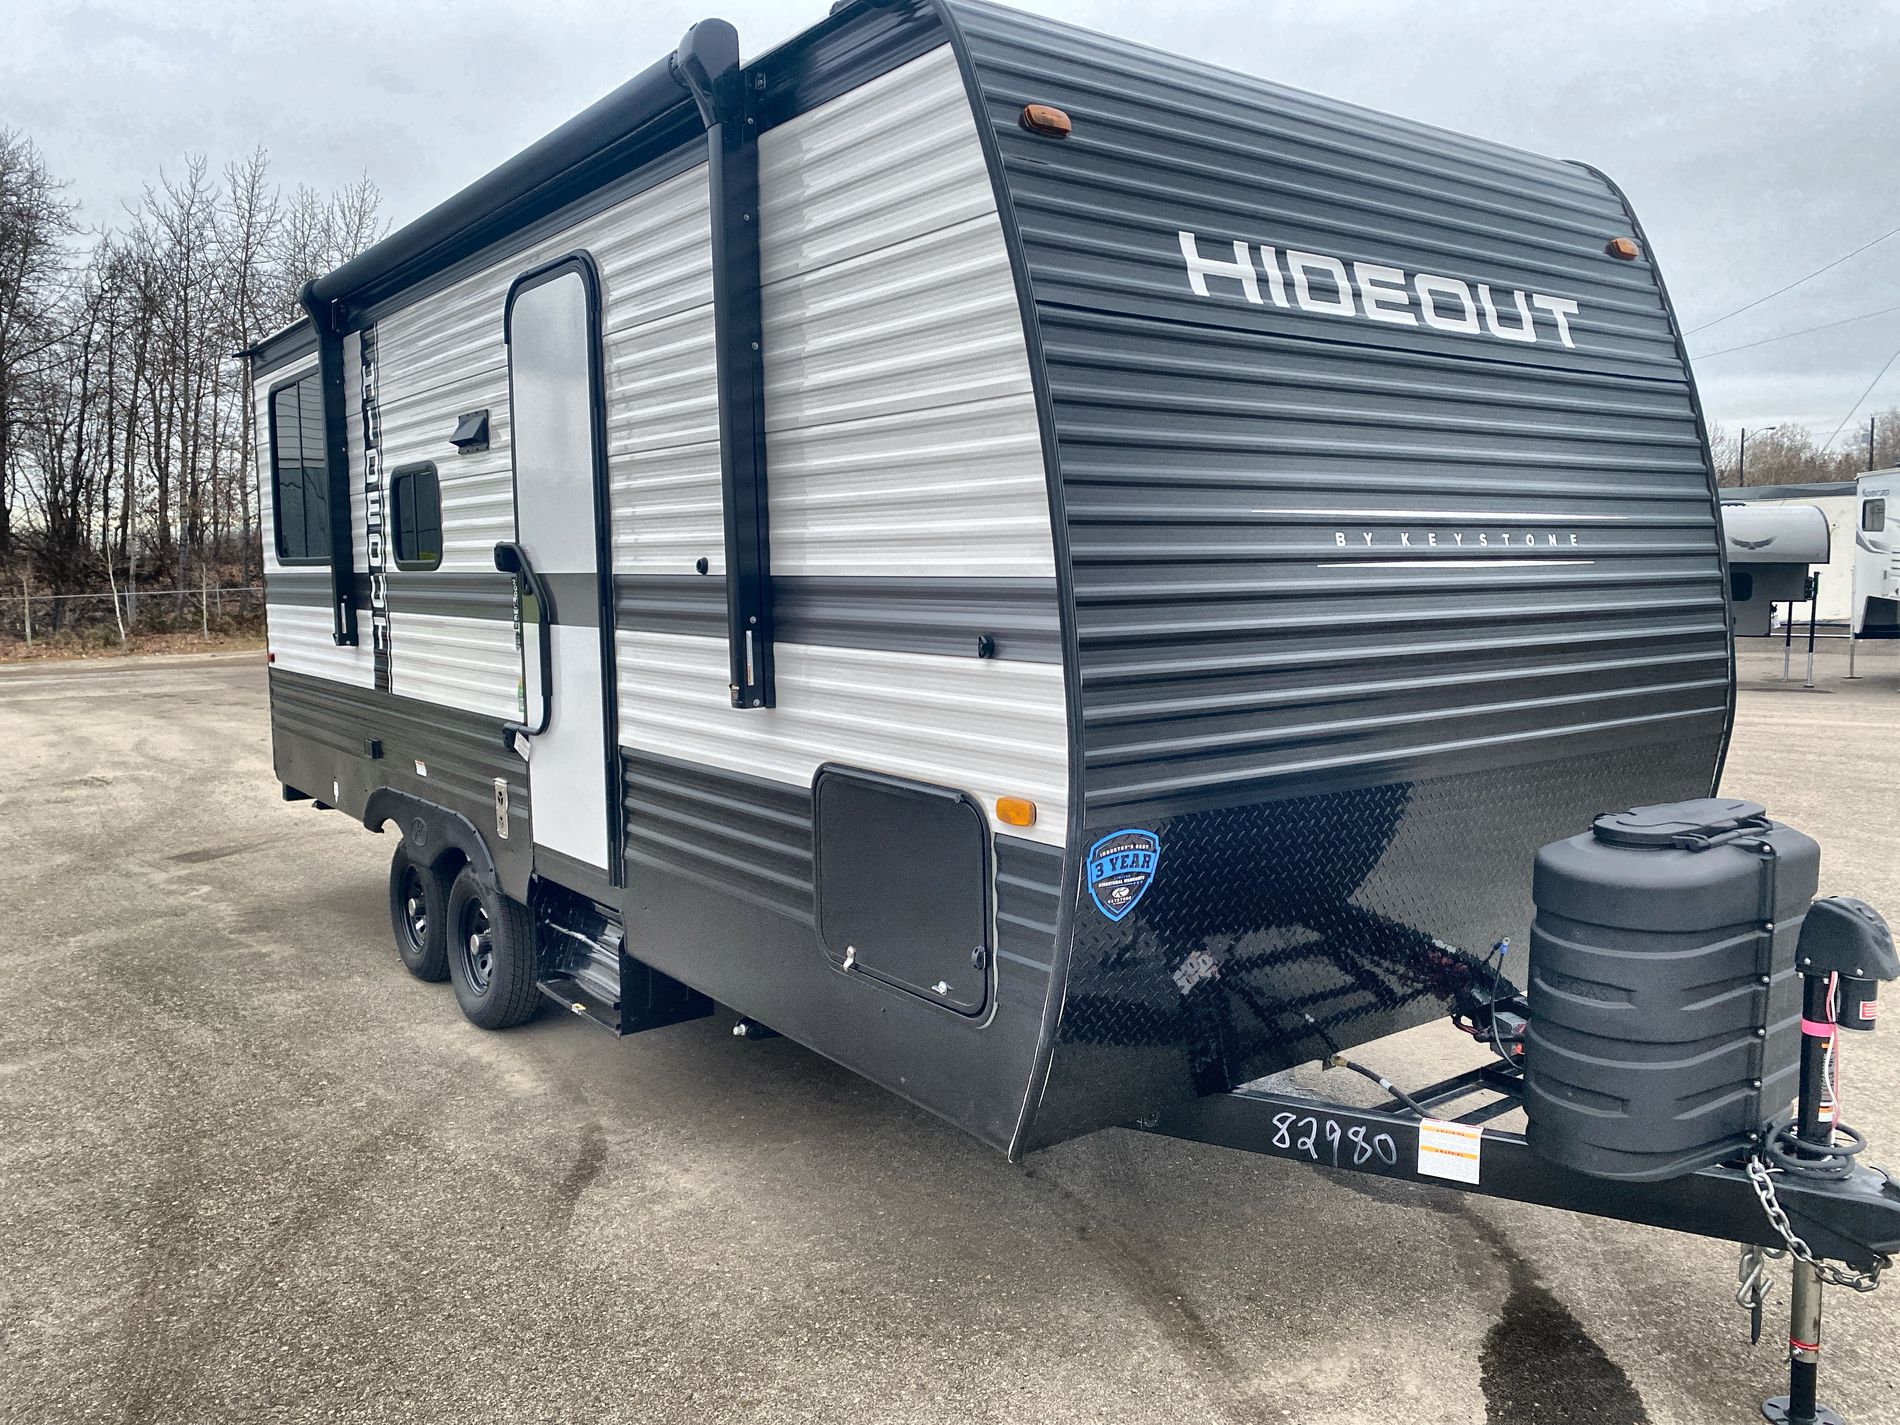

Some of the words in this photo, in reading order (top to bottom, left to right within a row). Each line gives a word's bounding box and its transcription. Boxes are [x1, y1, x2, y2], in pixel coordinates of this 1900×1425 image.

[1178, 230, 1580, 349] HIDEOUT
[361, 362, 386, 650] HIDEOUT
[1335, 532, 1373, 547] BY
[1401, 532, 1579, 548] KEYSTONE
[1095, 863, 1104, 878] 3
[1109, 854, 1151, 871] YEAR
[1271, 1112, 1397, 1167] 82980
